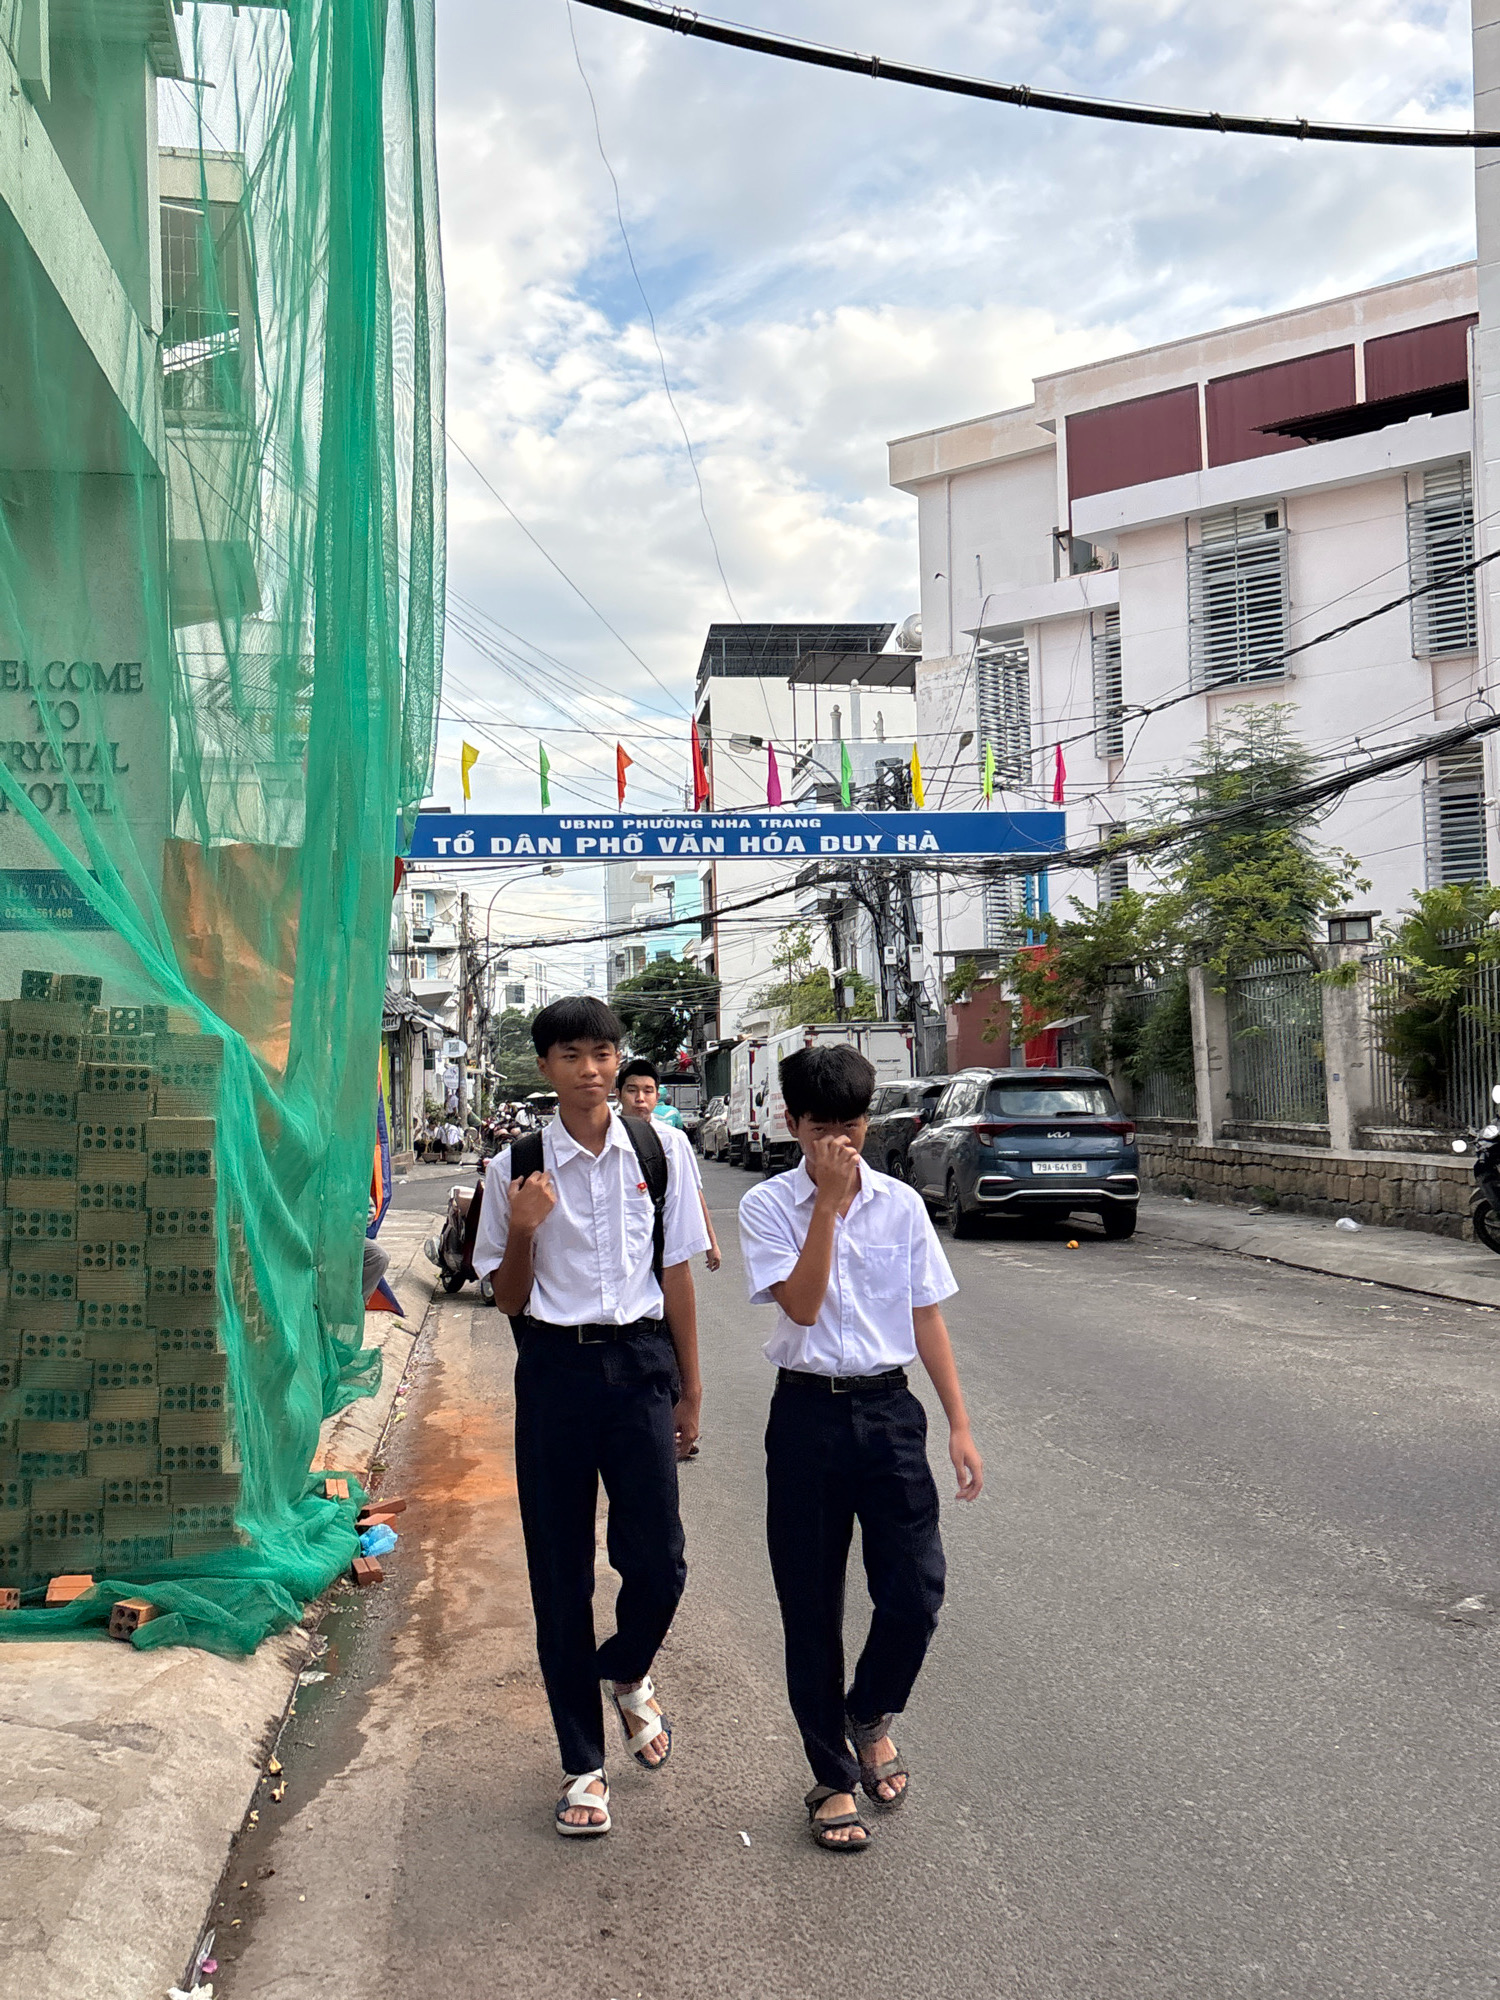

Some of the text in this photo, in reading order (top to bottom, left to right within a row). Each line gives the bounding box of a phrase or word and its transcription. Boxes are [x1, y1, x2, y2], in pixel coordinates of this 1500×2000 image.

[30, 699, 81, 733] TO
[559, 816, 822, 830] UBND PHƯỜNG NHA TRANG
[432, 829, 940, 855] TỔ DÂN PHỐ VĂN HÓA DUY HÀ
[34, 879, 74, 900] TÂN
